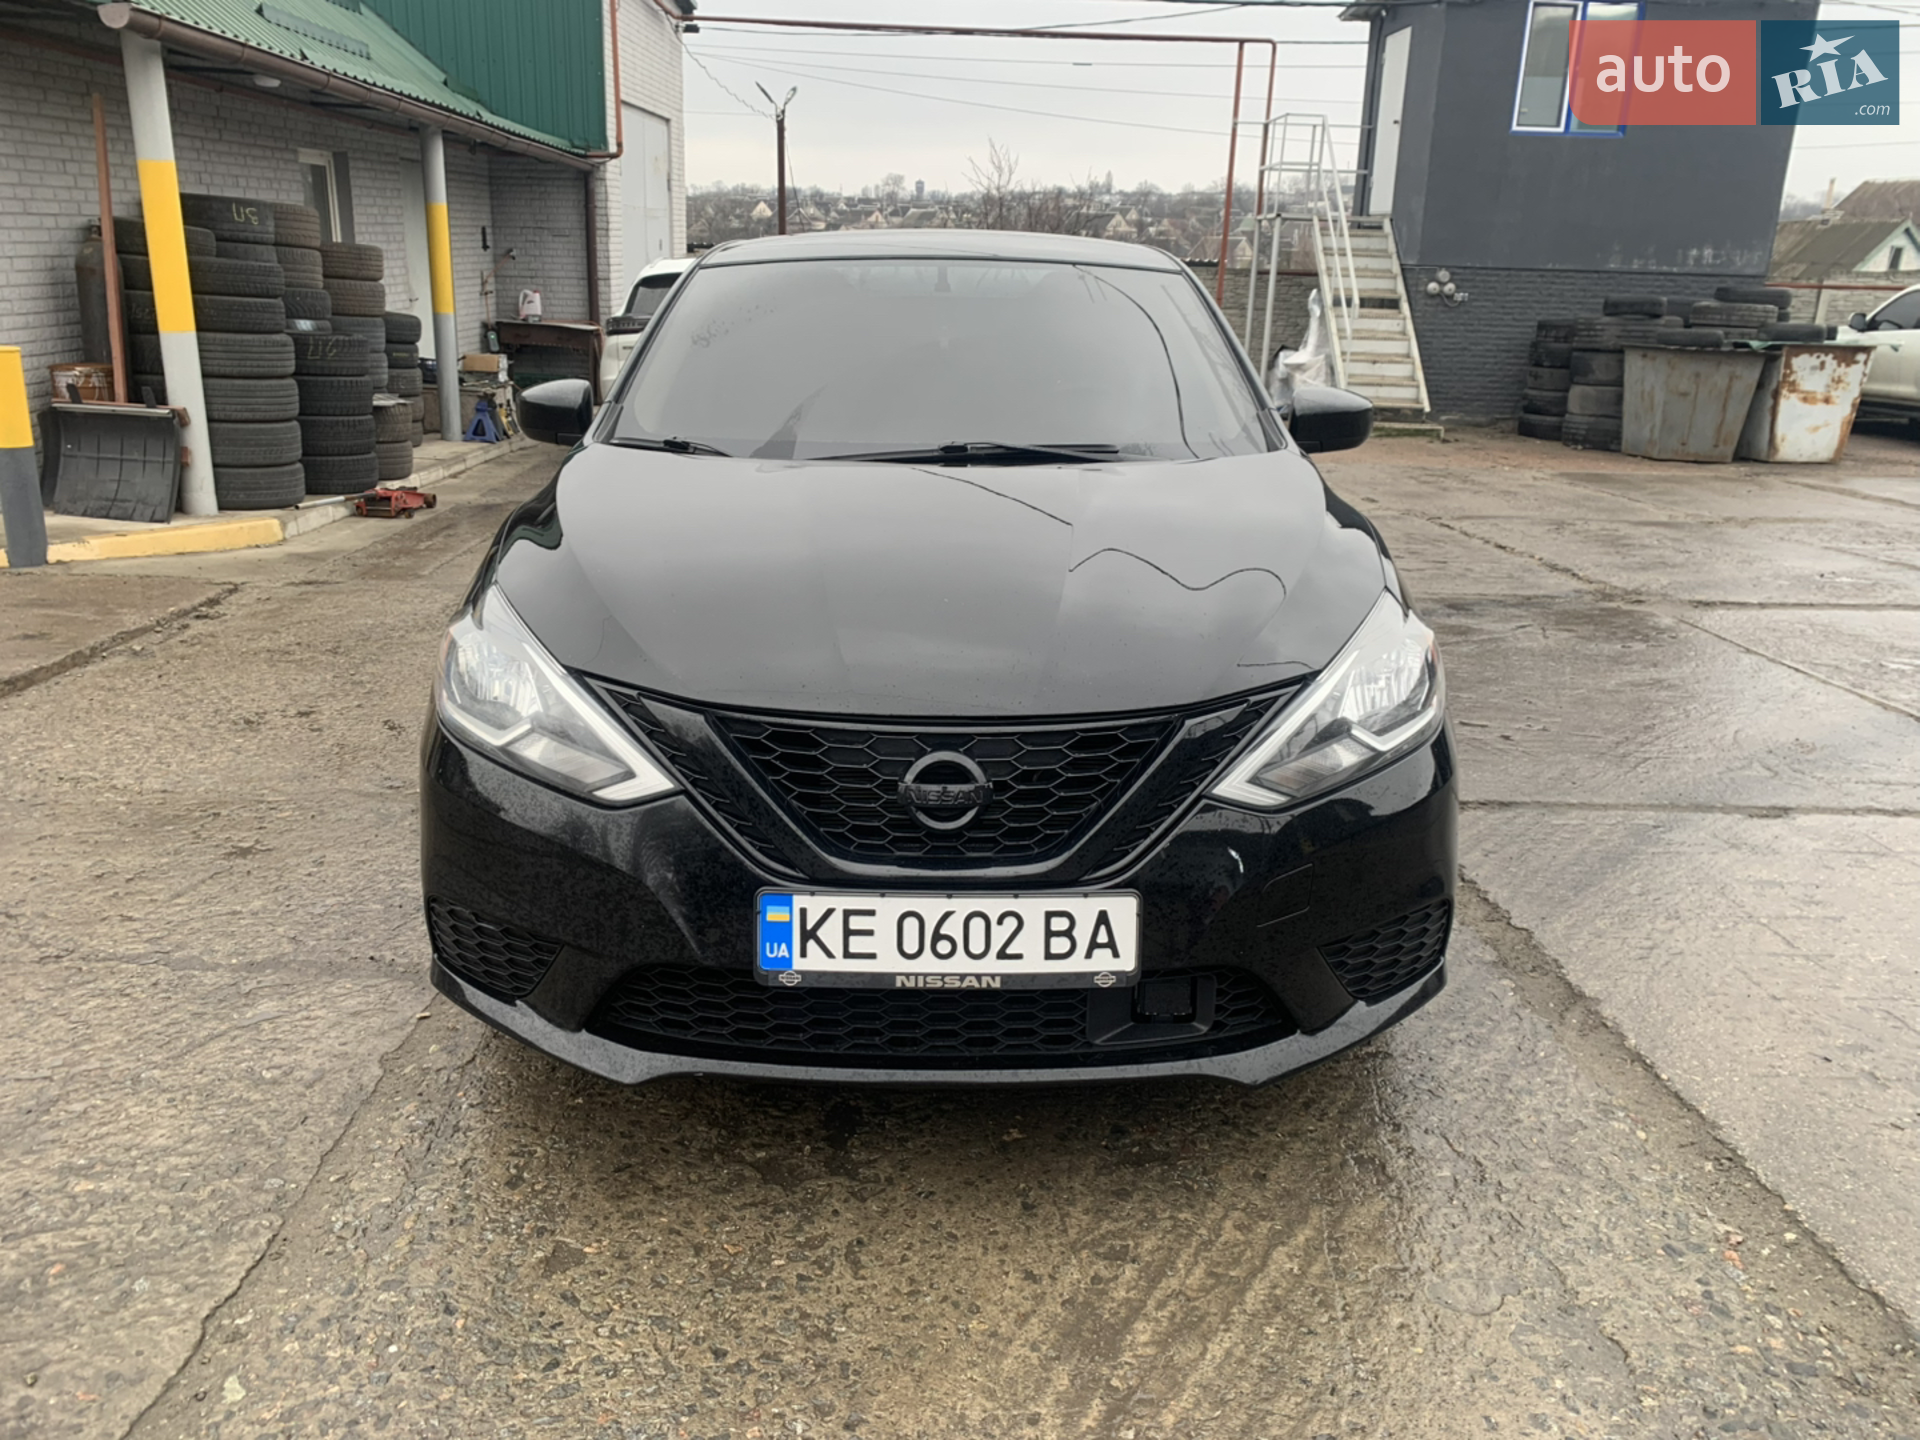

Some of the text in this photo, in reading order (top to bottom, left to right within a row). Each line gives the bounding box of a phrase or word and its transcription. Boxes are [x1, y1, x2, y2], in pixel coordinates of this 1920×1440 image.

[907, 788, 984, 805] NISSAN
[799, 907, 1121, 961] KE 0602 BA
[765, 942, 790, 958] UA
[895, 974, 1002, 988] NISSAN
